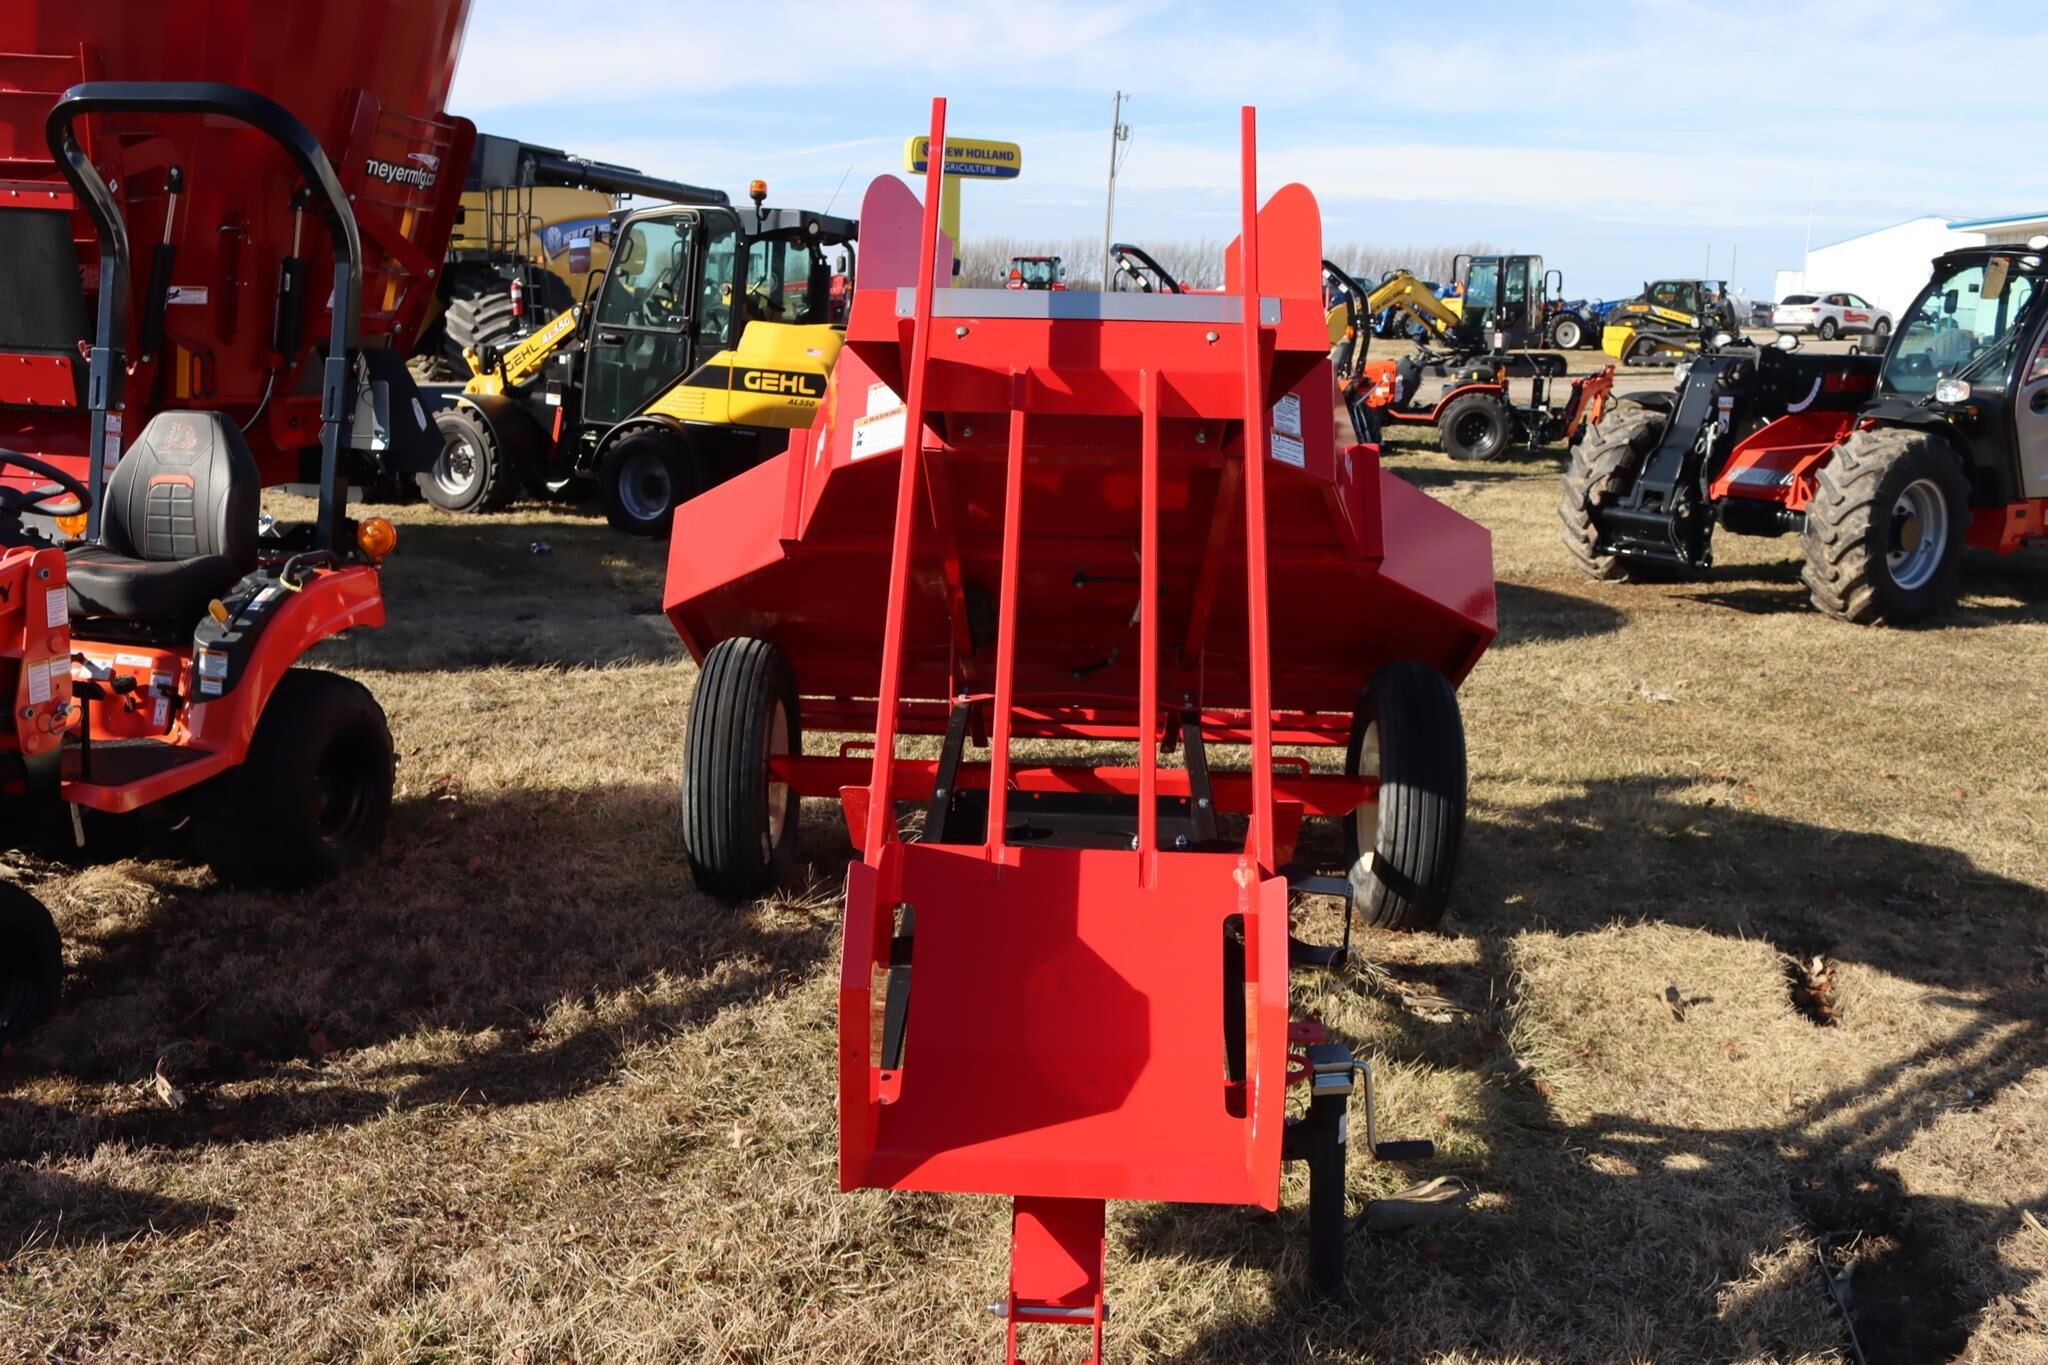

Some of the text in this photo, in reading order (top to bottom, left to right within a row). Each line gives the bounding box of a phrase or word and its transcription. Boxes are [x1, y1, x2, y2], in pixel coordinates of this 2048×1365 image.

[944, 146, 1014, 160] EW HOLLAND
[943, 163, 997, 174] GRICULTURE
[505, 344, 540, 372] GEHL
[743, 371, 816, 395] GEHL
[787, 398, 816, 407] AL550
